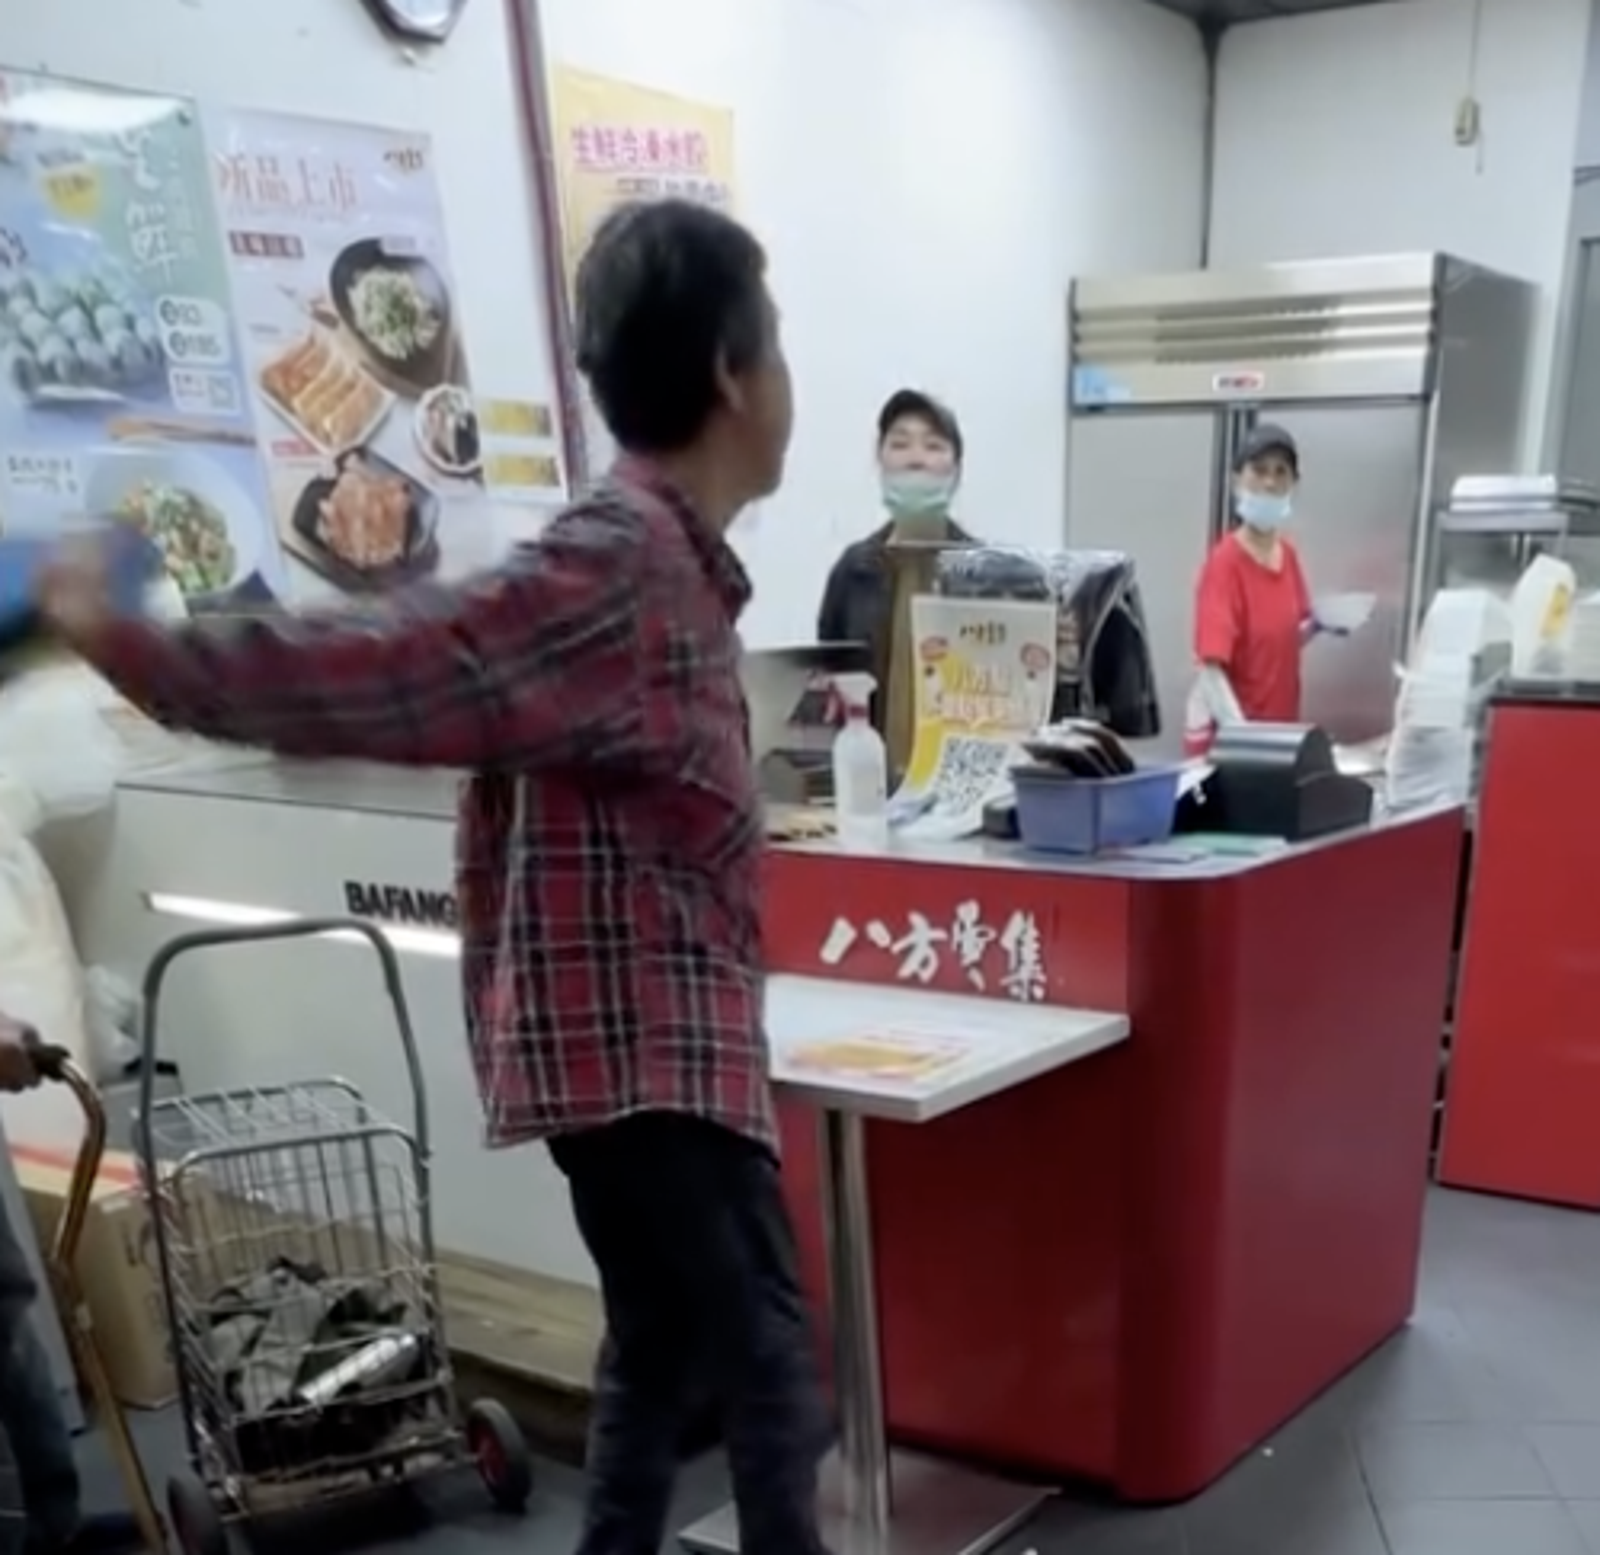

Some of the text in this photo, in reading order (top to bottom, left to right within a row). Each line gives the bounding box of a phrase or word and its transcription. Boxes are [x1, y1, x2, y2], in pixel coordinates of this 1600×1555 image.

[345, 880, 457, 927] BAFANG
[819, 899, 1047, 1001] 八方雲集
